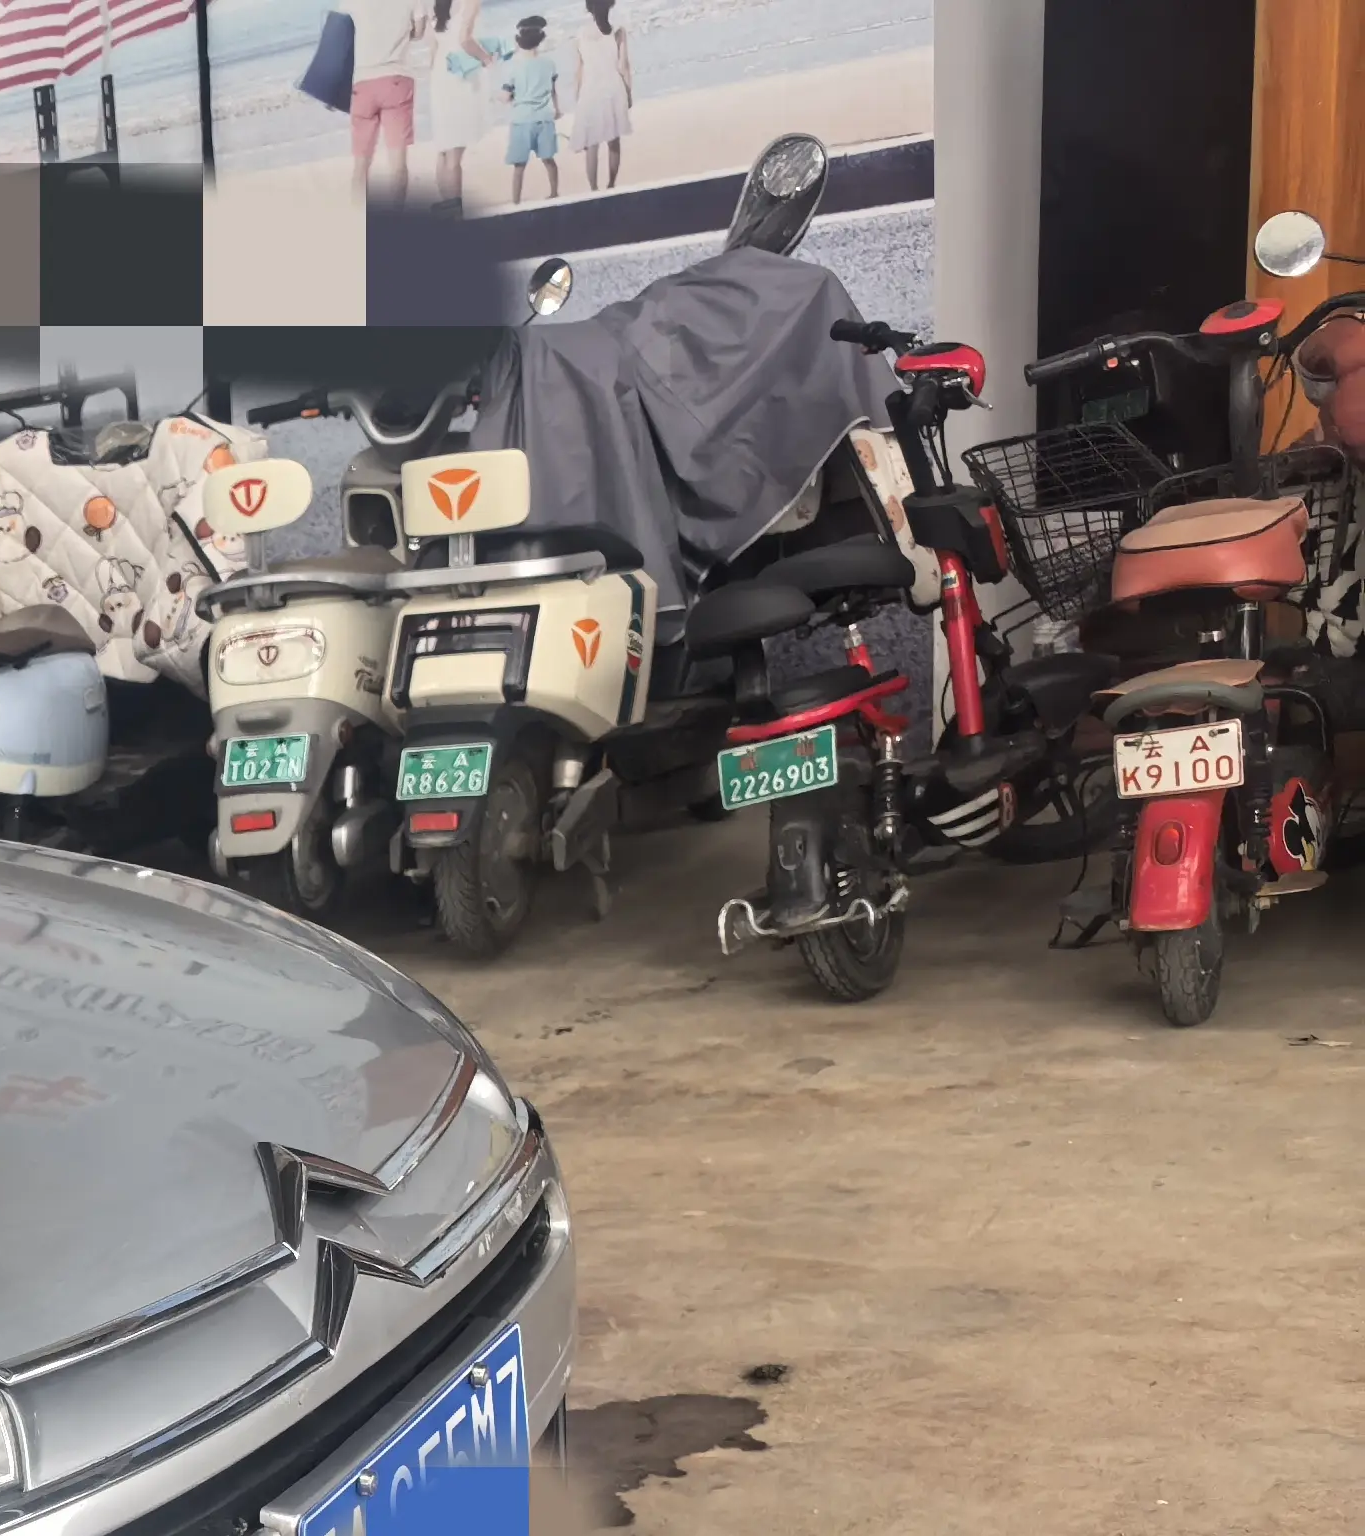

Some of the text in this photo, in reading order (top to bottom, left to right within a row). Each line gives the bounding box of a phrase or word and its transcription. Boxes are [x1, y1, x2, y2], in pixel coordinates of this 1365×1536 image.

[1142, 735, 1211, 760] 云 A
[229, 756, 302, 782] T027N
[729, 755, 830, 802] 2226903
[1122, 755, 1234, 792] K9100
